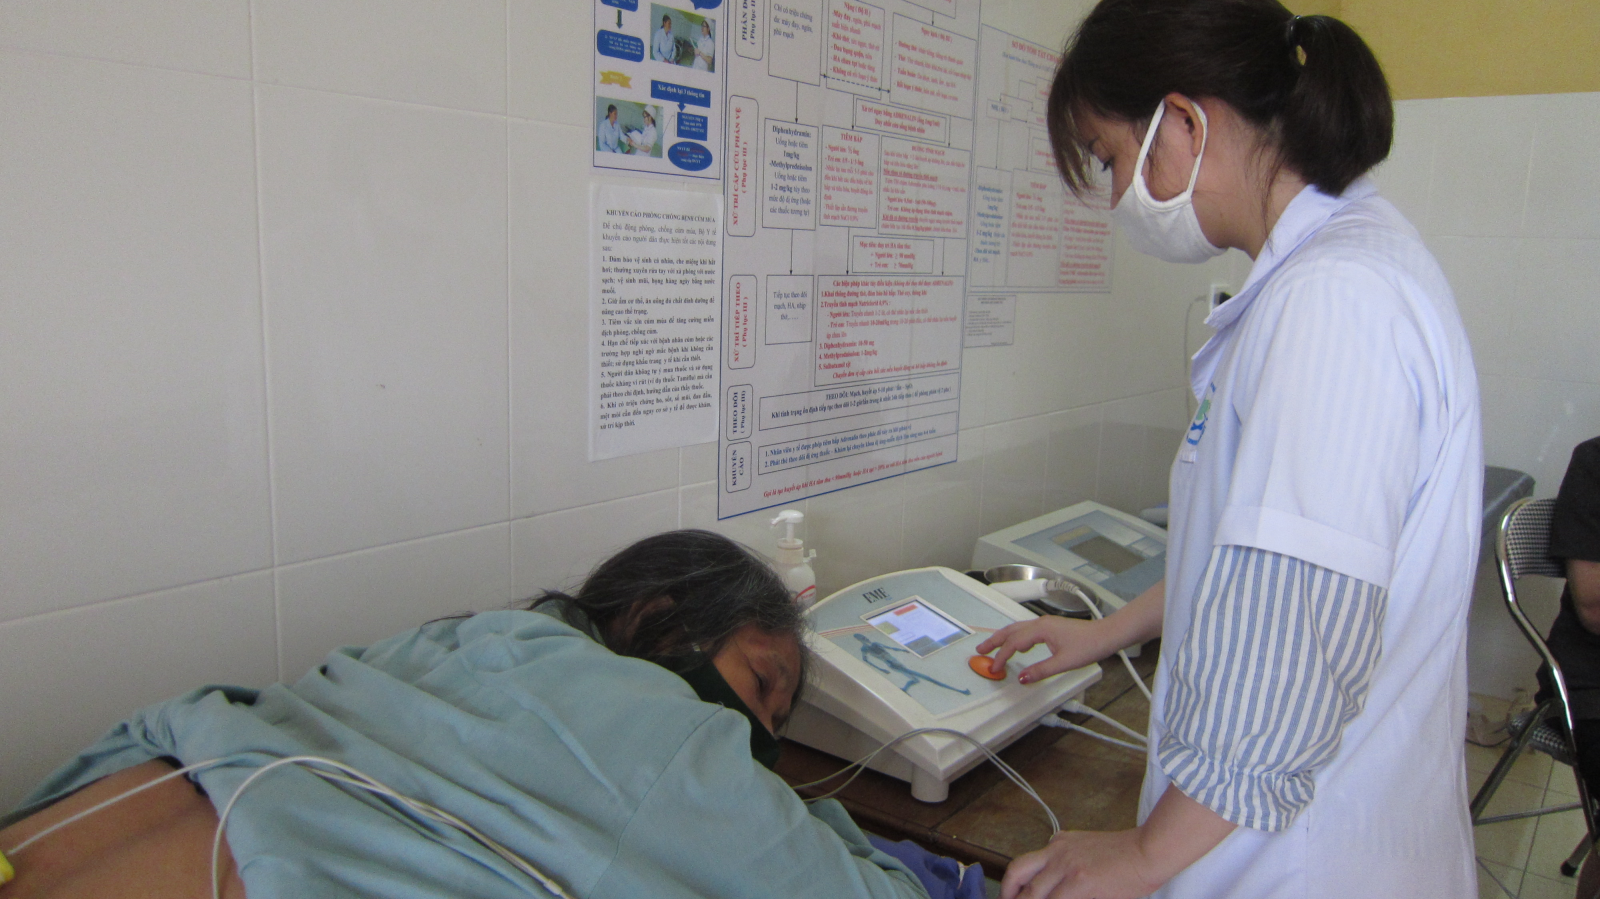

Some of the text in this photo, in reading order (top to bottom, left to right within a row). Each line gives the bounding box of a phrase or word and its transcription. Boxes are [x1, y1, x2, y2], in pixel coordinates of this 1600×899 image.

[742, 0, 748, 9] Đ
[732, 211, 738, 225] XỬ
[735, 107, 742, 119] VỆ
[734, 349, 739, 362] XỬ
[862, 587, 890, 603] EME
